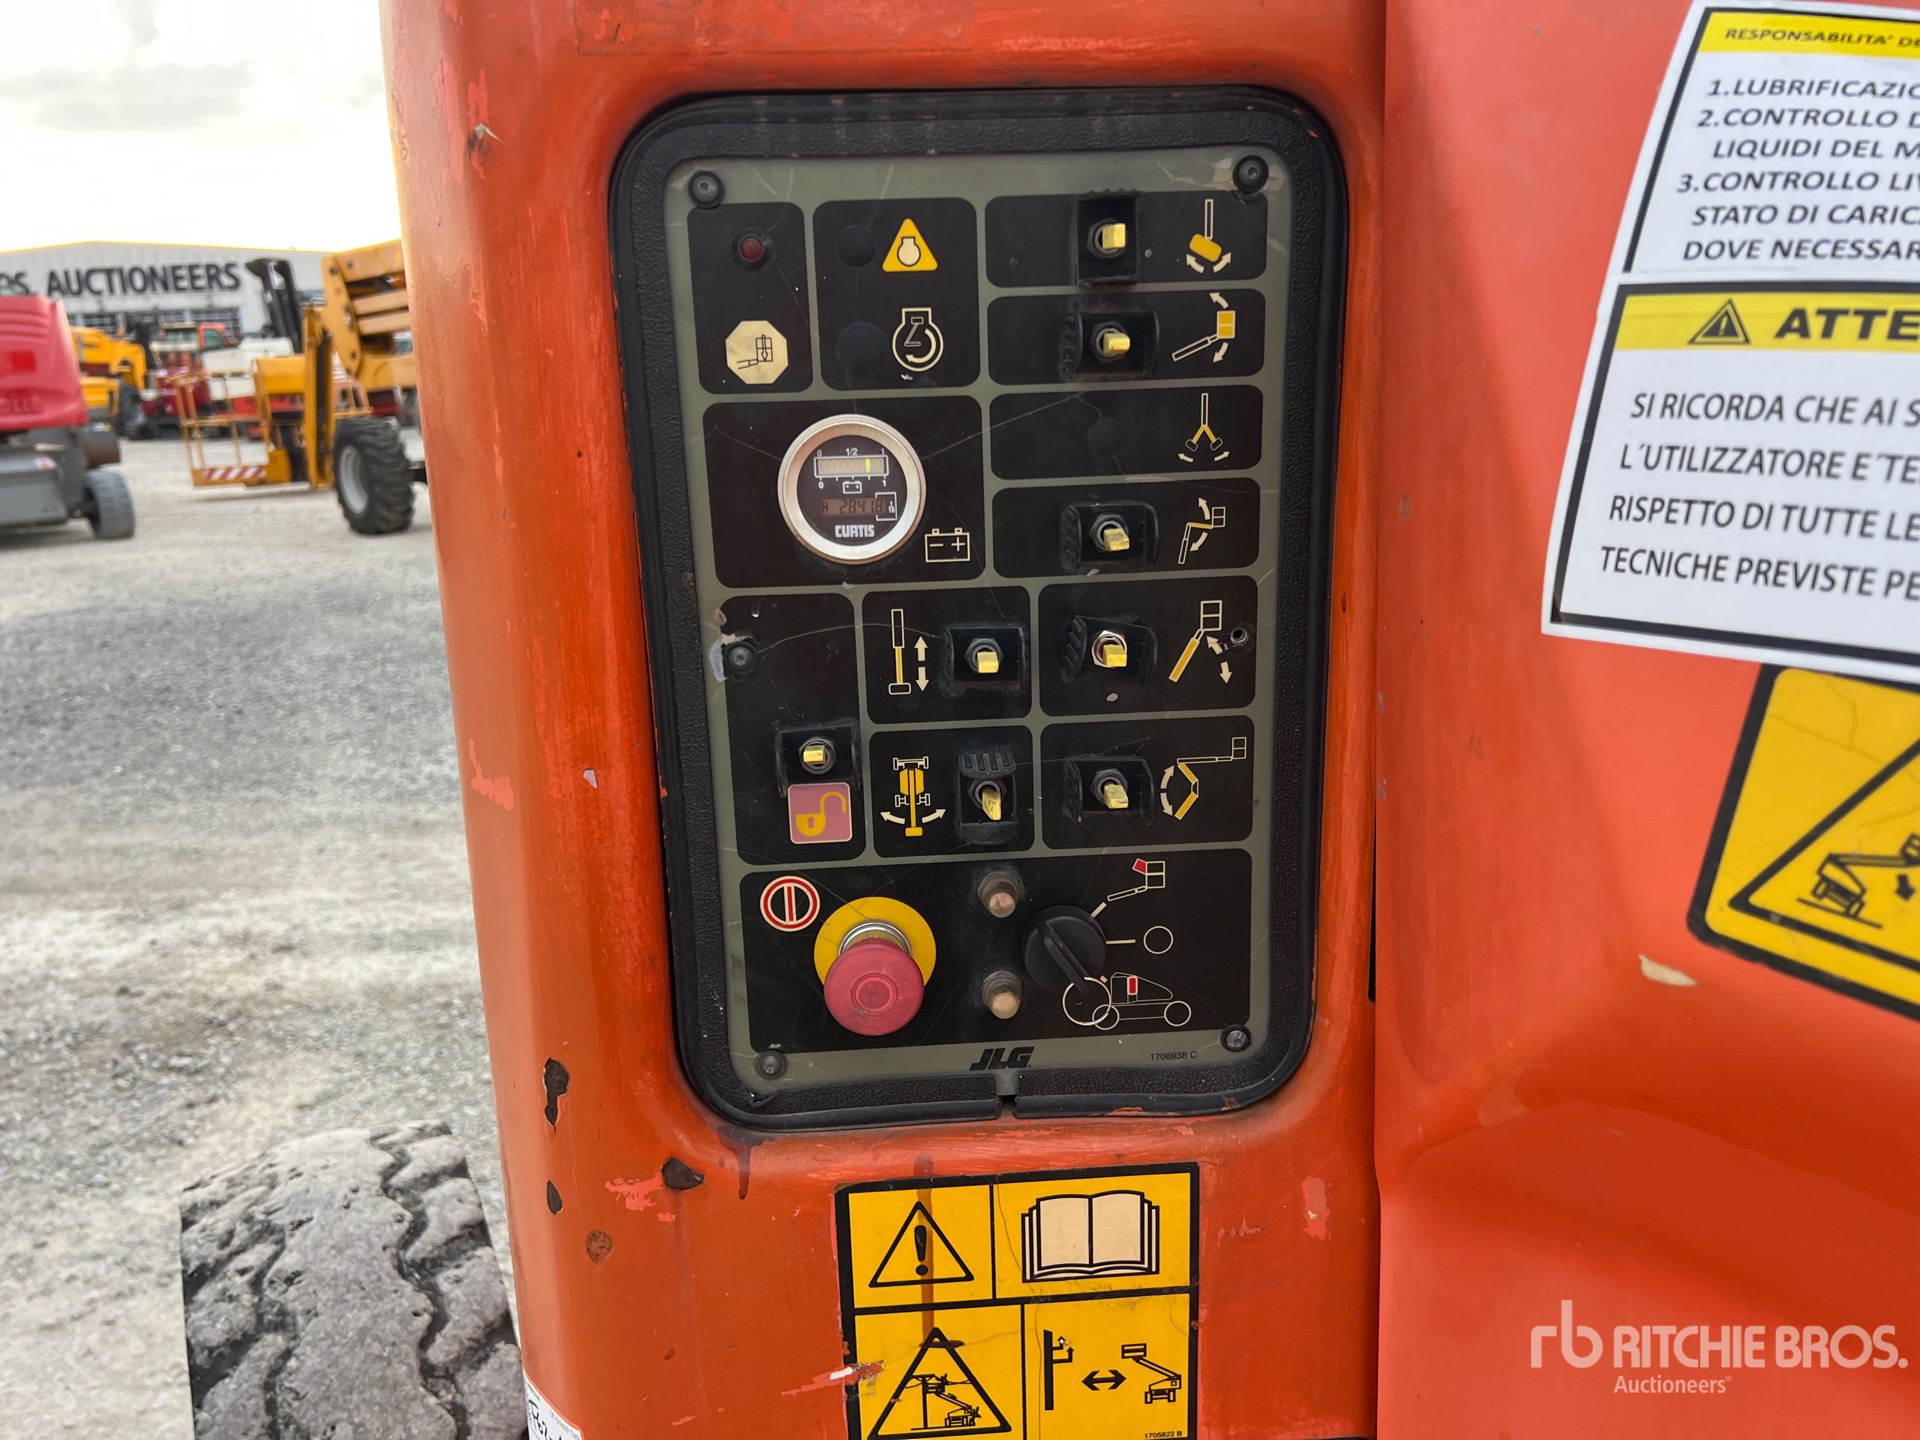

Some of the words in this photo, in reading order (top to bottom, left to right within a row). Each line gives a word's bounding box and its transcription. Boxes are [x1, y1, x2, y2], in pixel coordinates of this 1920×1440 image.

[1697, 108, 1898, 128] 2.CONTROLLO
[1712, 139, 1821, 160] LIQUIDI
[1829, 139, 1884, 159] DEL
[1677, 171, 1880, 193] 3.CONTROLLO
[1691, 205, 1778, 226] STATO
[1787, 204, 1819, 225] DI
[1827, 204, 1920, 225] CARIC
[1682, 240, 1763, 261] DOVE
[1770, 239, 1920, 260] NECESSAR
[47, 262, 242, 297] AUCTIONEERS
[1773, 308, 1920, 342] ATTE
[1630, 393, 1656, 418] SI
[1660, 394, 1785, 422] RICORDA
[1795, 395, 1860, 424] CHE
[1861, 398, 1899, 426] AI
[1609, 495, 1735, 528] RISPETTO
[1742, 502, 1775, 532] DI
[1781, 504, 1880, 539] TUTTE
[1884, 511, 1920, 542] LE
[834, 524, 876, 539] CURTIS
[1600, 546, 1730, 583] TECNICHE
[1735, 557, 1878, 597] PREVISTE
[969, 1046, 1035, 1071] JLG
[1150, 1051, 1188, 1062] 1706938
[1189, 1050, 1198, 1060] C
[1144, 1430, 1175, 1439] 1705822
